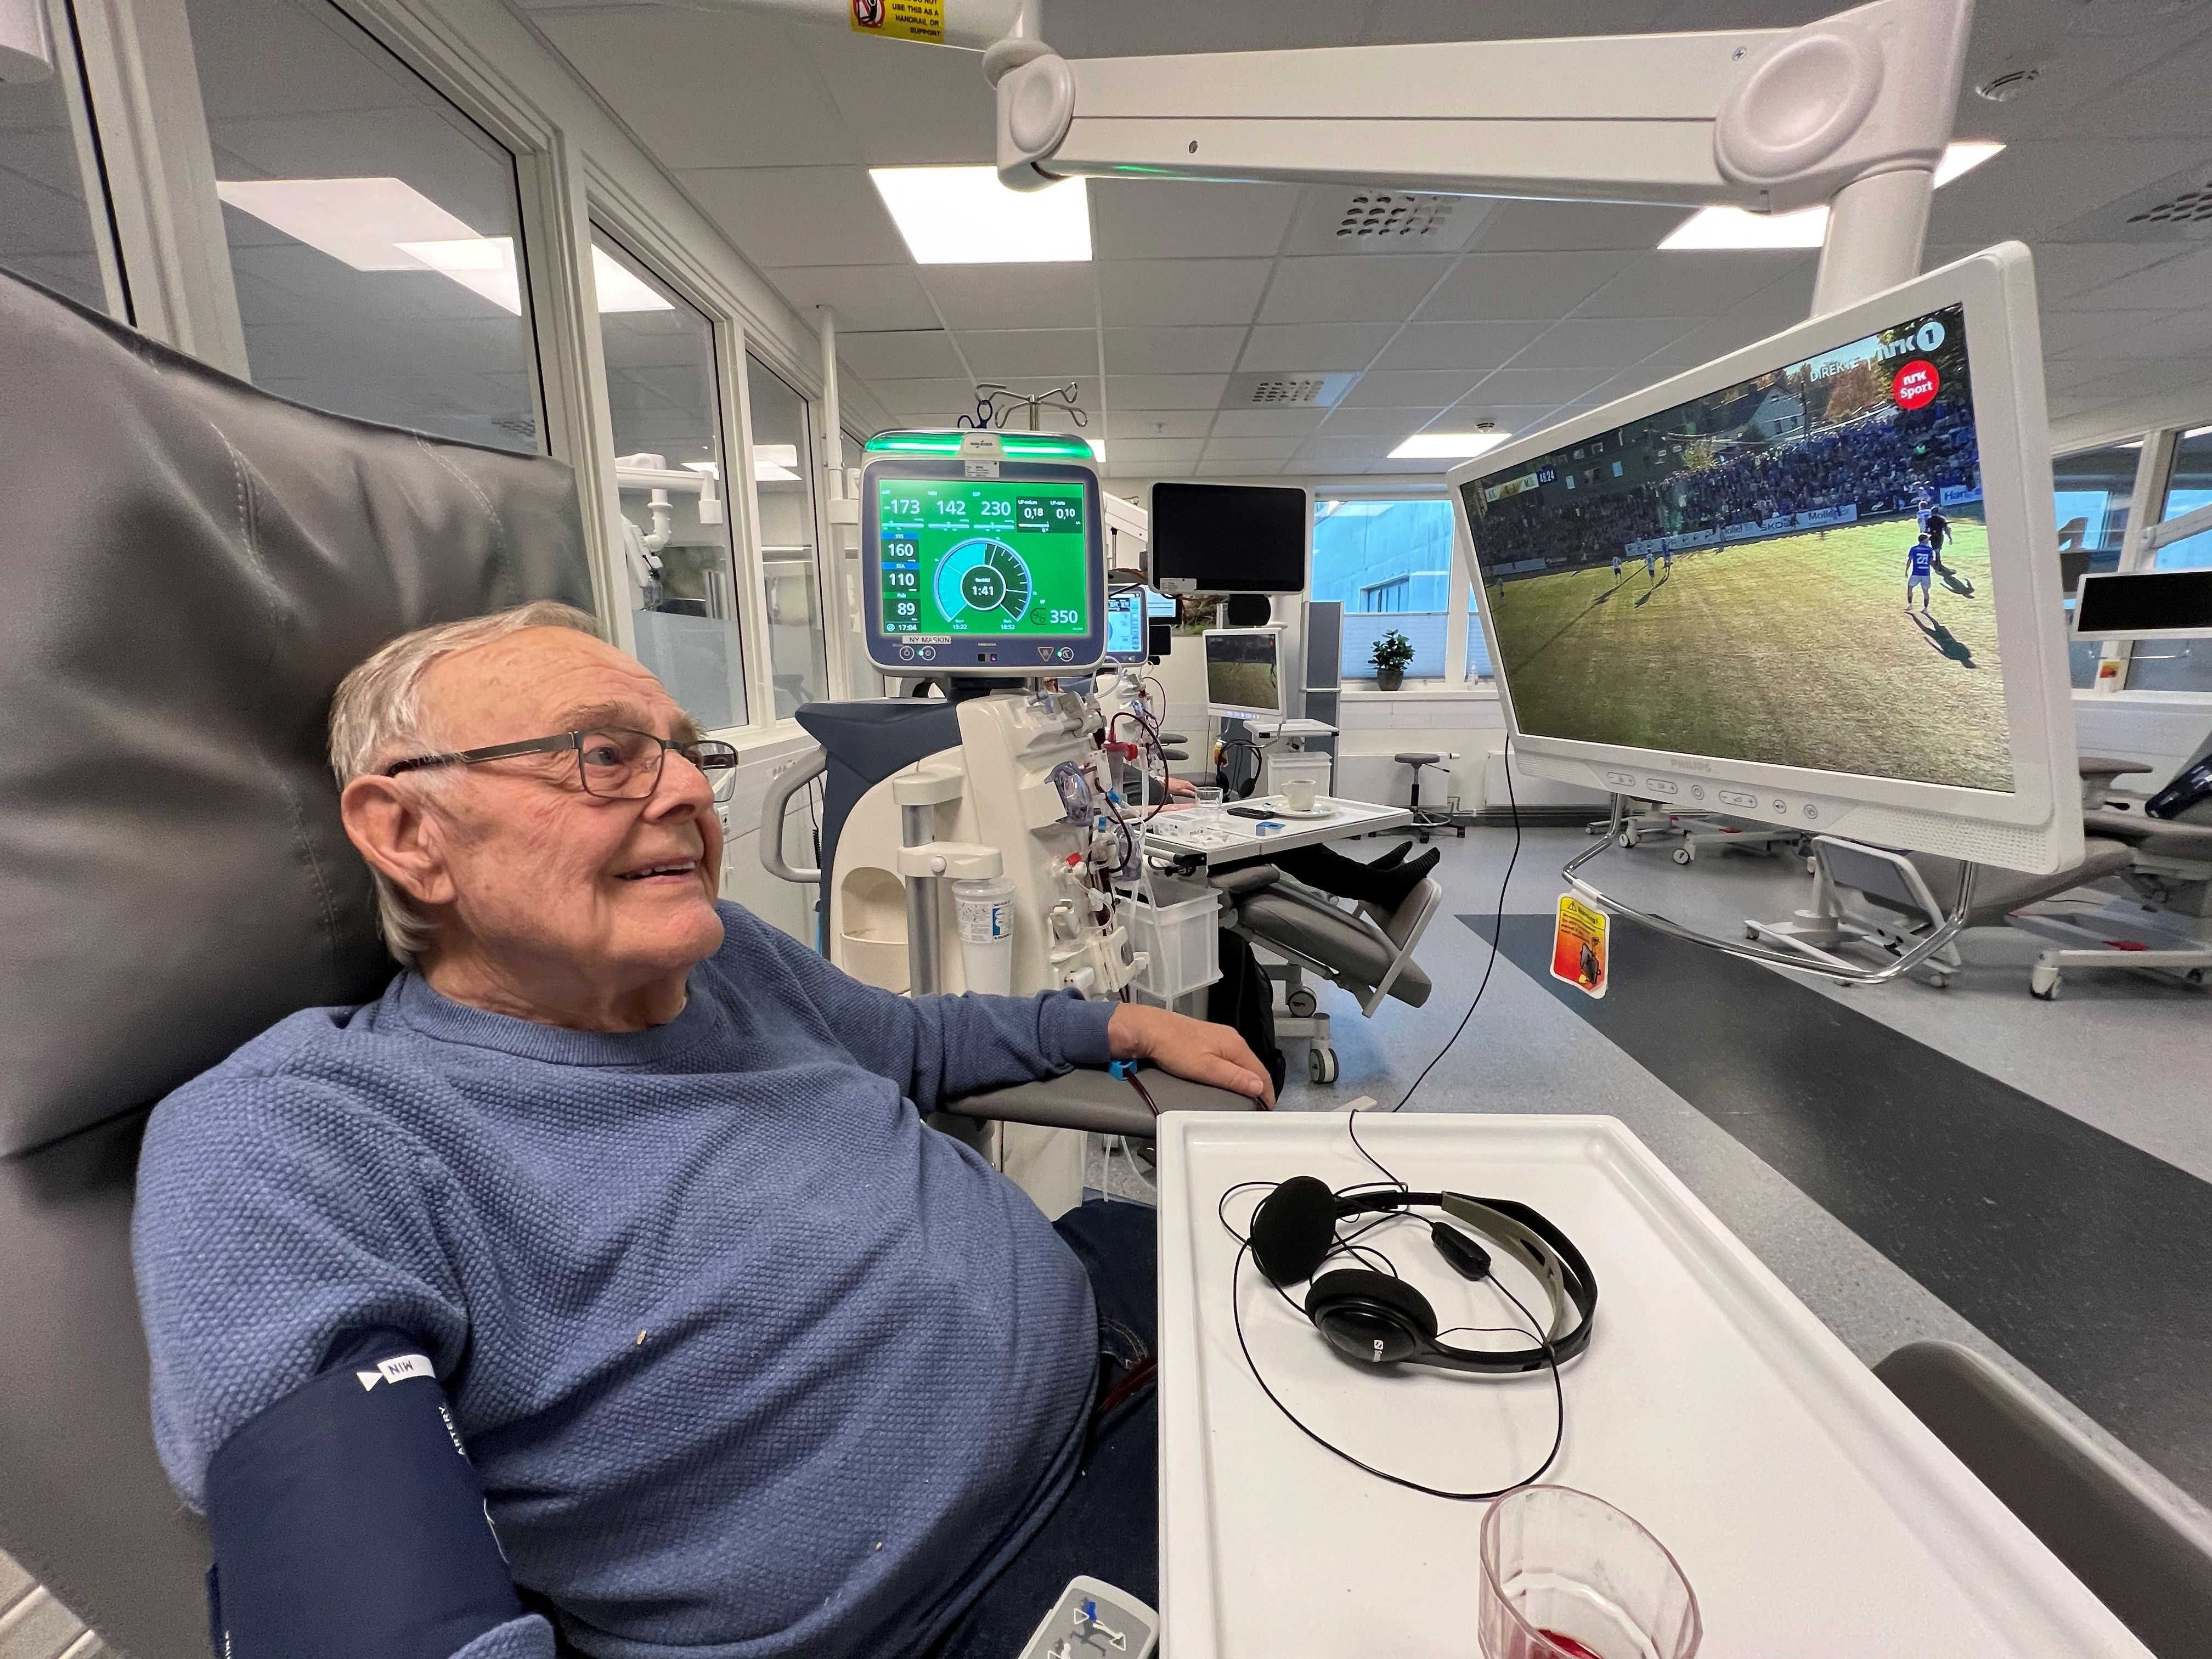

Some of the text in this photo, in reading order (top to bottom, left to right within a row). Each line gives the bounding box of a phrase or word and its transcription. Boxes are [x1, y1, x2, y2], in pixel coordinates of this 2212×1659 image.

[895, 14, 927, 25] HANDRAIL
[910, 27, 941, 37] SUPPORT
[1900, 381, 1933, 400] Sport
[884, 500, 920, 515] -173
[937, 500, 966, 515] 142
[981, 501, 1011, 516] 230
[888, 544, 913, 557] 160
[889, 573, 915, 586] 110
[972, 585, 994, 596] 1:41
[898, 602, 915, 616] 89
[1050, 610, 1078, 624] 350
[387, 1361, 414, 1375] MIN
[438, 1406, 465, 1455] ARTERY
